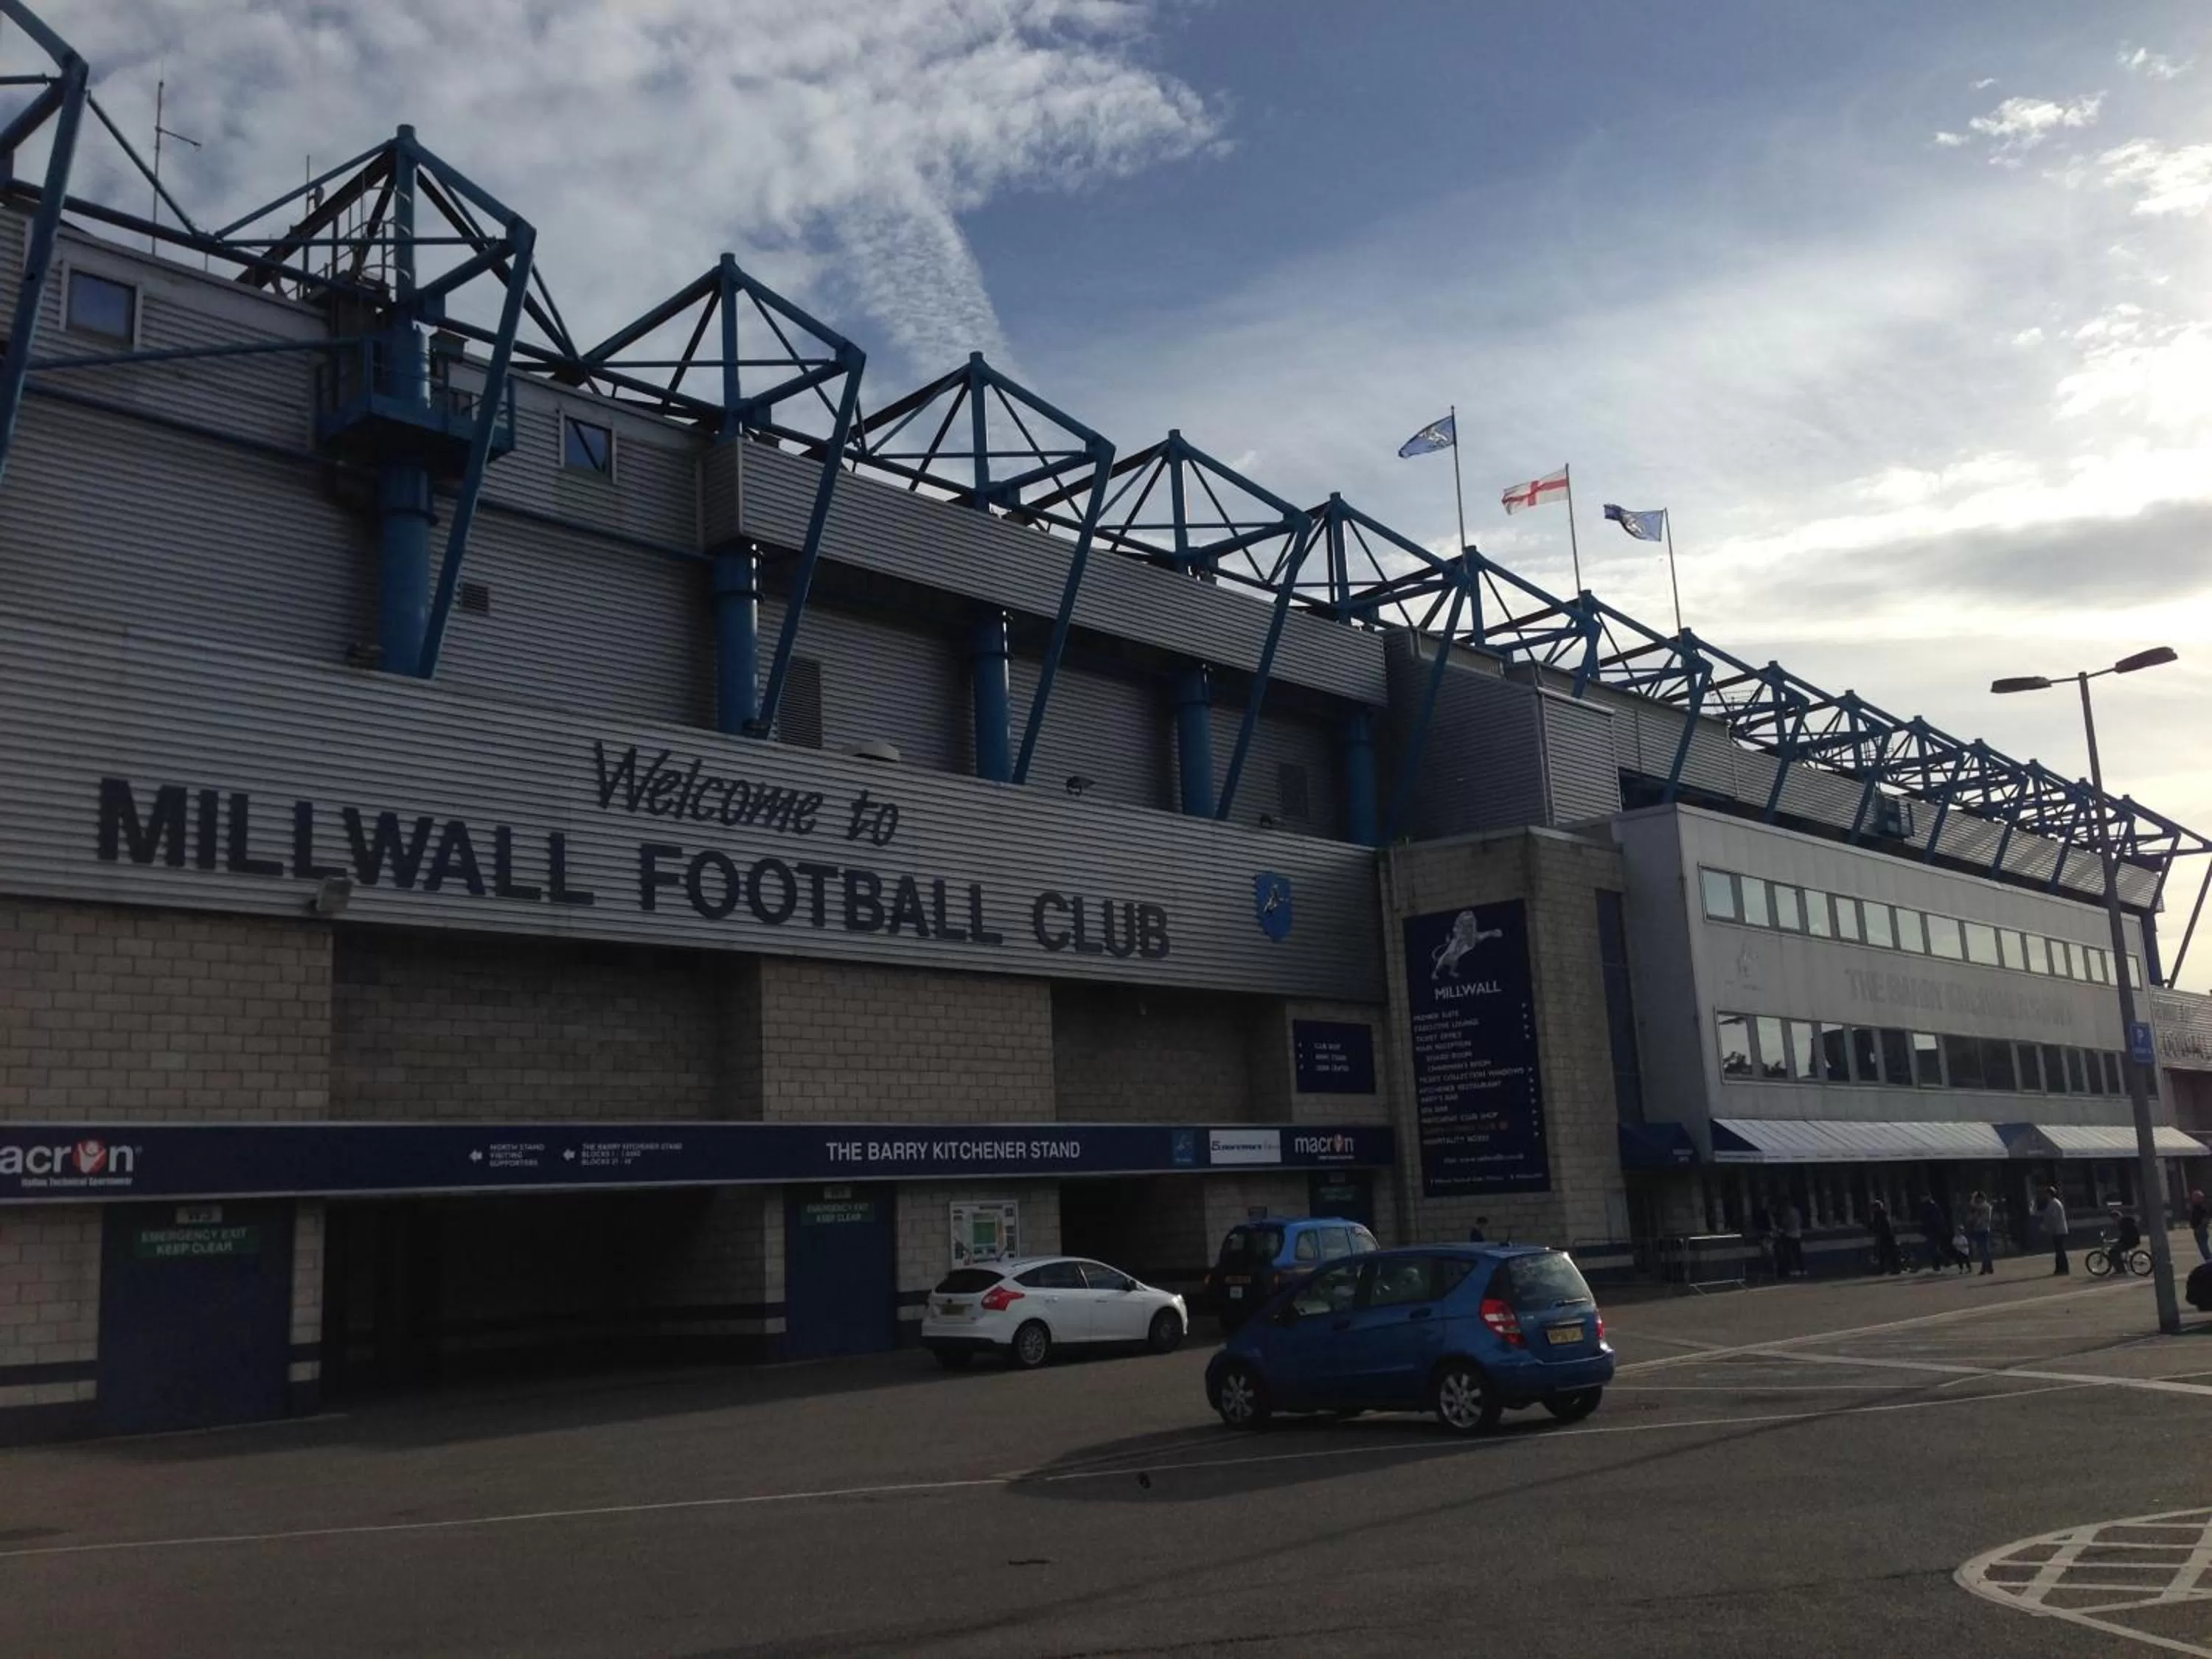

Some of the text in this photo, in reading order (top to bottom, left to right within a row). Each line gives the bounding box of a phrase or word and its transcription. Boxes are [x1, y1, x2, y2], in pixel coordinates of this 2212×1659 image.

[595, 740, 899, 847] Welcome to
[97, 777, 1170, 959] MILLWALL FOOTBALL CLUB
[1434, 980, 1503, 1000] MILLWALL
[826, 1141, 1081, 1161] THE BARRY KITCHENER STAND
[1294, 1134, 1355, 1153] macron
[156, 1240, 233, 1256] KEEP CLEAR
